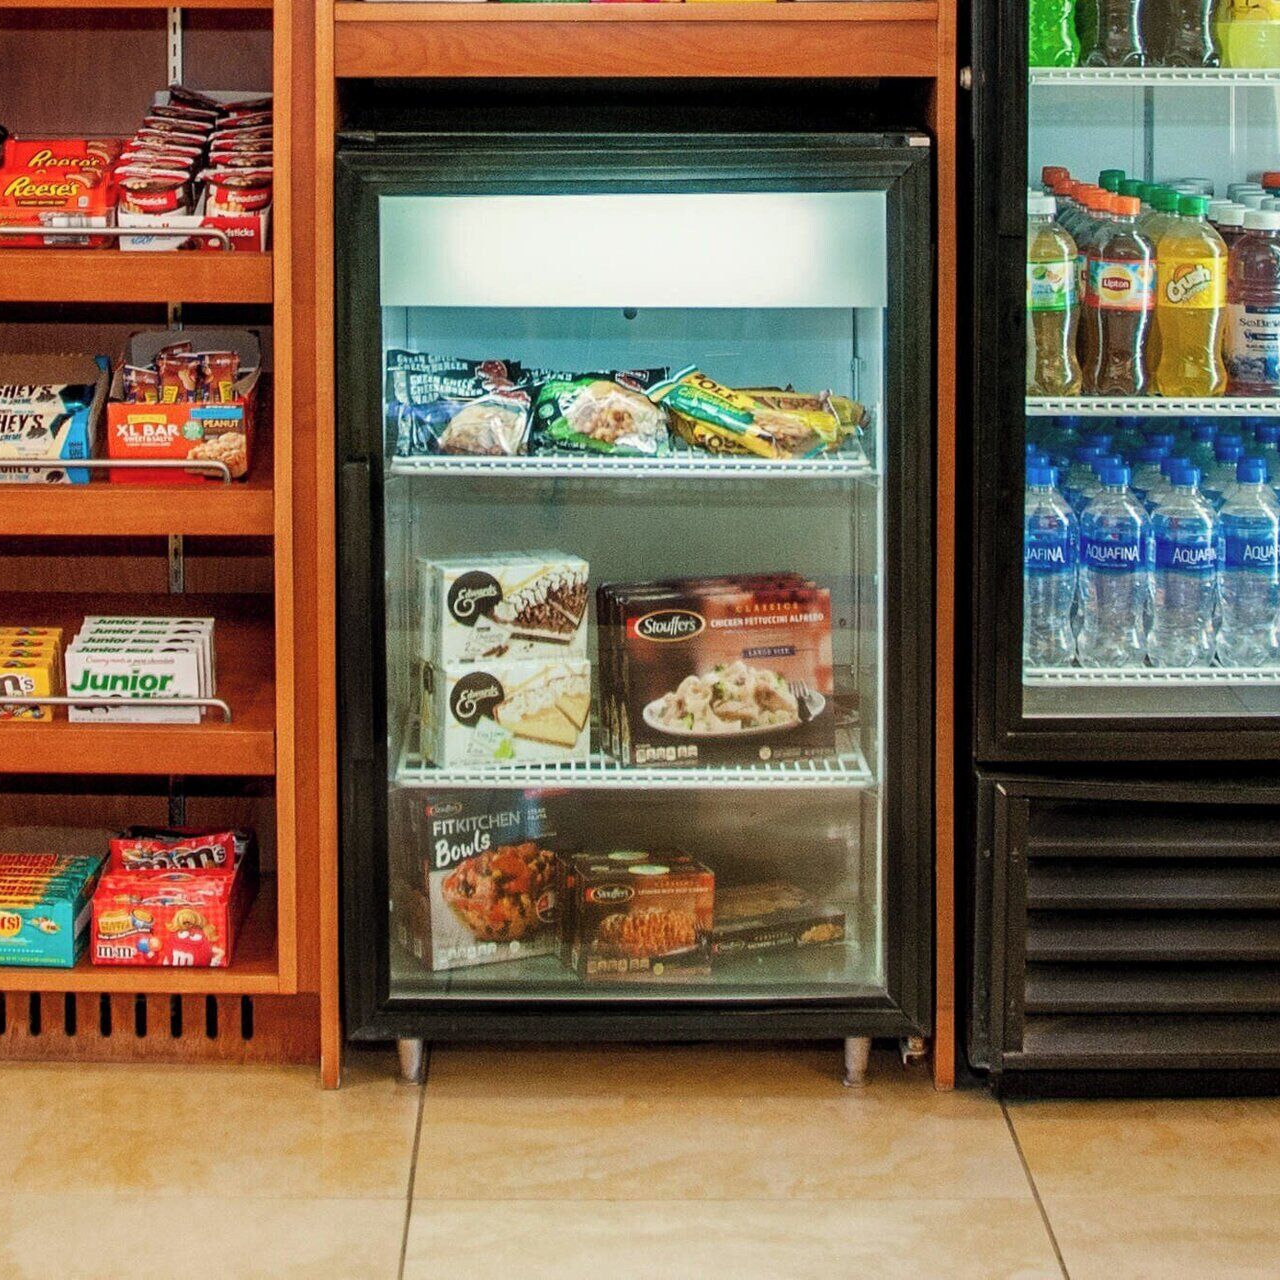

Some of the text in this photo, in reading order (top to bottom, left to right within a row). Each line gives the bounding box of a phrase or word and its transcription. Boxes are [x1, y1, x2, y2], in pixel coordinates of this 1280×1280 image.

[4, 176, 80, 198] Reese's
[1103, 278, 1130, 290] Lipton
[1166, 263, 1212, 303] Crush
[116, 424, 180, 437] XL BAR
[203, 419, 239, 428] PEANUT
[1086, 543, 1141, 563] AQUAFINA
[454, 584, 498, 617] Edwards
[93, 618, 140, 626] Junior
[643, 615, 697, 636] Stouffer's
[710, 618, 744, 628] CHICKEN
[789, 613, 825, 623] ALFREDO
[90, 627, 136, 635] Junior
[82, 636, 128, 645] Junior
[76, 645, 122, 654] Junior
[71, 669, 174, 692] Junior
[456, 685, 500, 719] Edwards
[434, 830, 491, 868] Bowls
